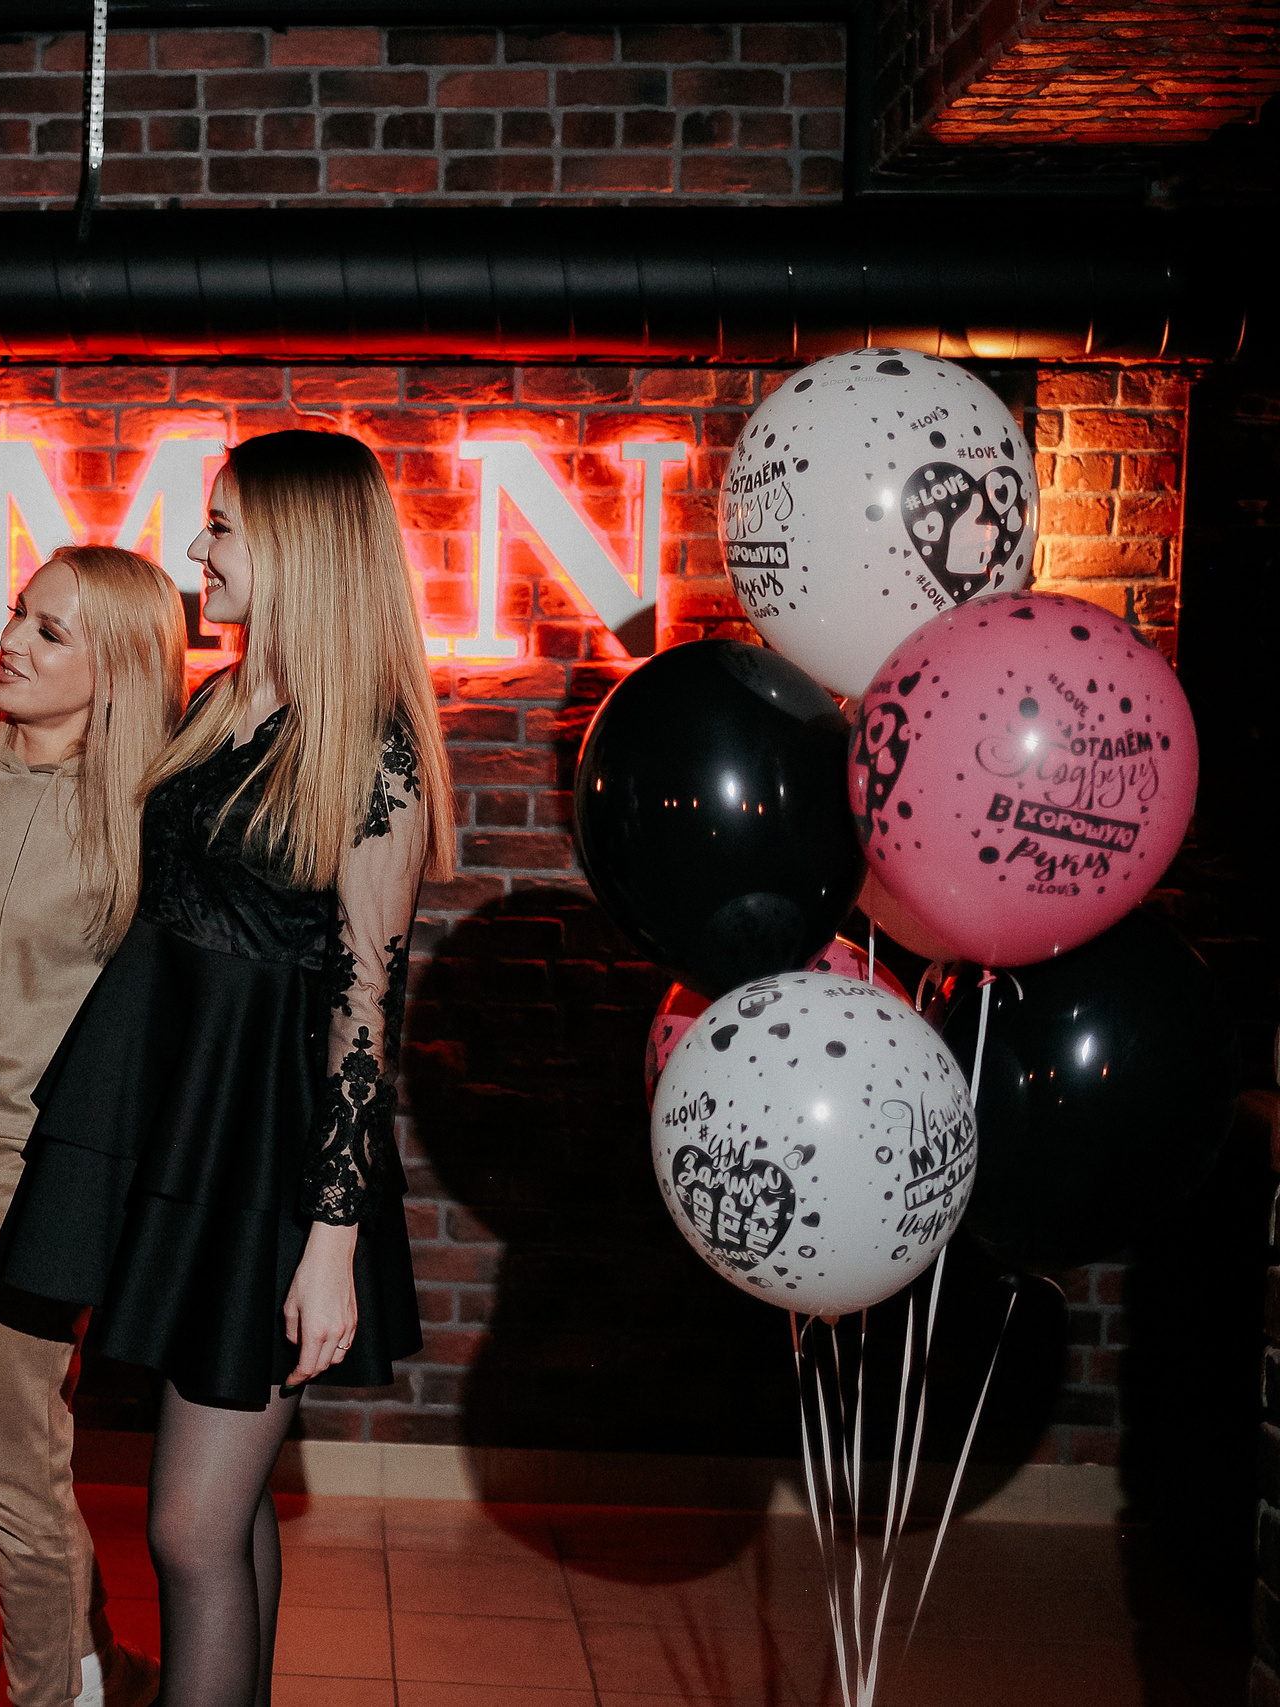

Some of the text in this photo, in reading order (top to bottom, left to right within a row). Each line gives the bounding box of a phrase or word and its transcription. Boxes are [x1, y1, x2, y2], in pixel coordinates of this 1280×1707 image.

[910, 406, 949, 432] #LOVE
[957, 446, 998, 460] #LOVE
[731, 460, 787, 495] ОТДАЁМ
[904, 473, 970, 510] #LOVE
[916, 574, 947, 612] #LOVE
[1047, 673, 1090, 718] #LOVE
[1070, 729, 1153, 761] ОТДАЁМ
[986, 792, 1135, 849] В ХОРОШУЮ
[1026, 882, 1081, 897] #LOVE
[823, 985, 885, 999] #LOVE
[664, 1091, 716, 1127] #LOVE
[908, 1110, 973, 1179] МУЖА
[693, 1187, 714, 1240] НЕВ
[717, 1195, 743, 1245] ТЕР
[744, 1196, 781, 1254] ПЁЖ
[703, 1242, 738, 1273] #OVE
